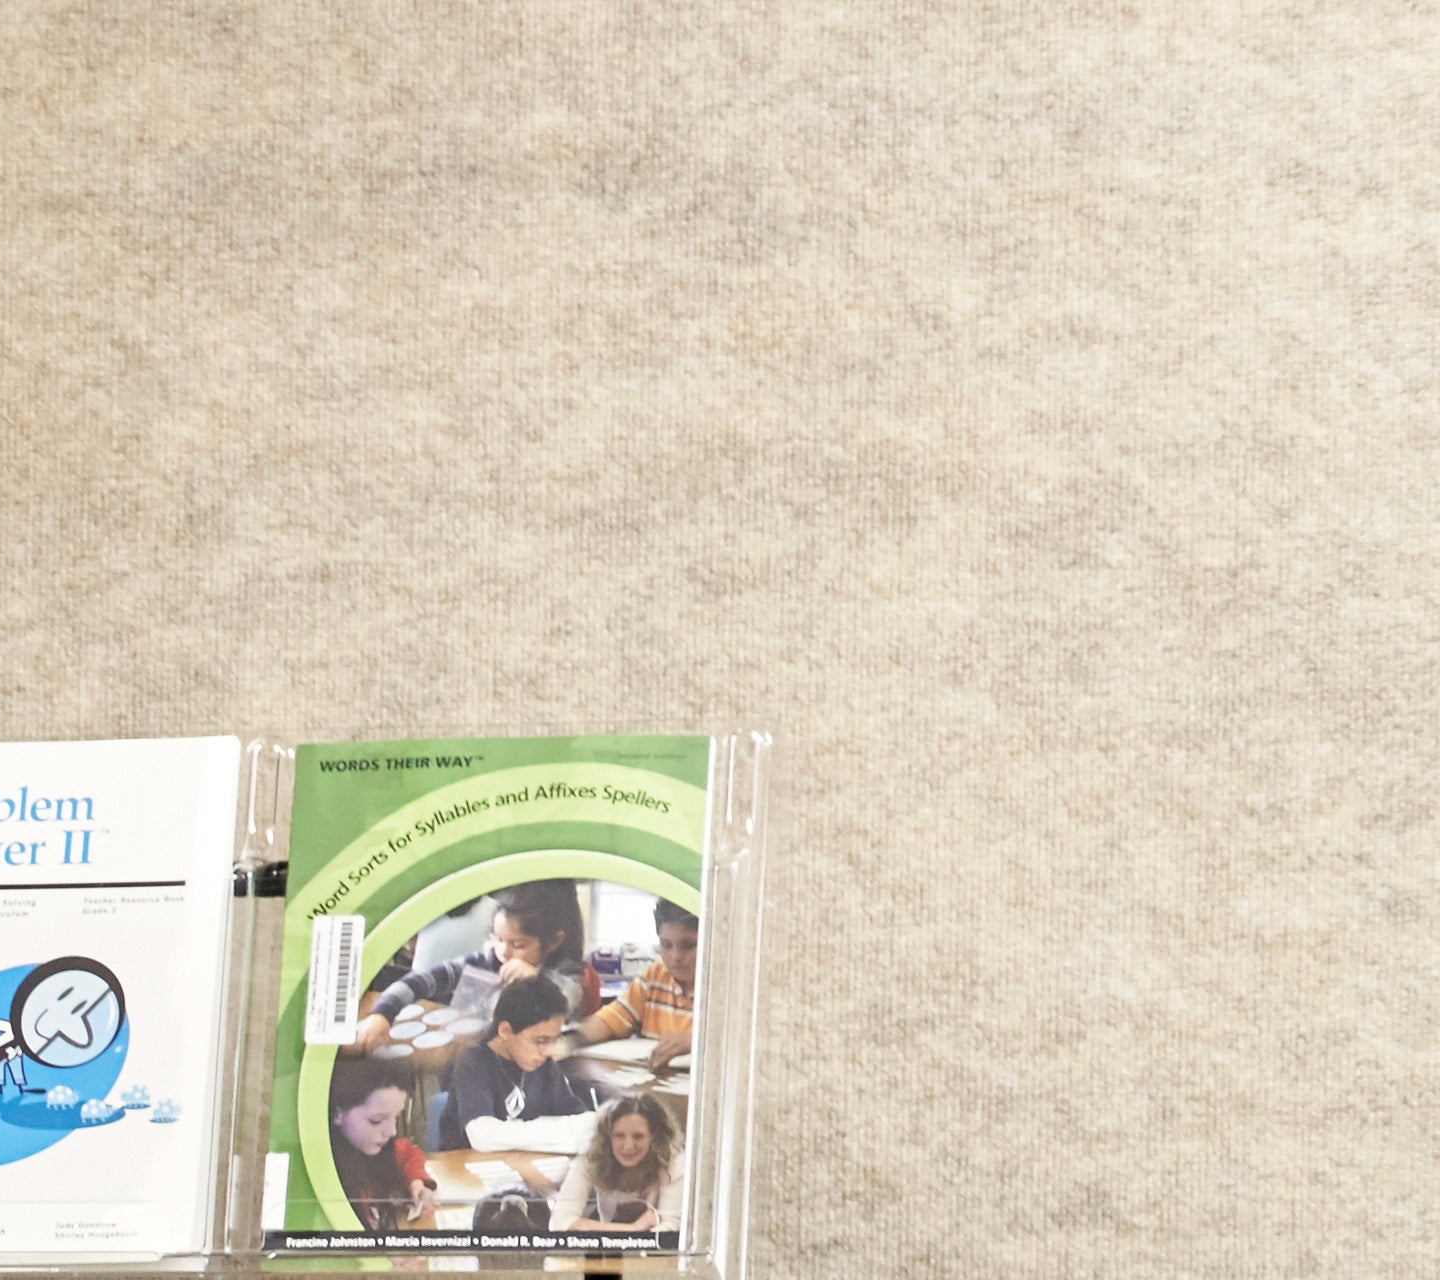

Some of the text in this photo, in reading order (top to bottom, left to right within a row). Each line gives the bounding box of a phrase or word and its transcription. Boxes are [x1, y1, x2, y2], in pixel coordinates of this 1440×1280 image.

[320, 759, 380, 772] WORDS
[385, 757, 430, 771] THEIR
[60, 830, 95, 865] II
[306, 783, 671, 919] Word Sorts for Syllables and Affixes Spellers
